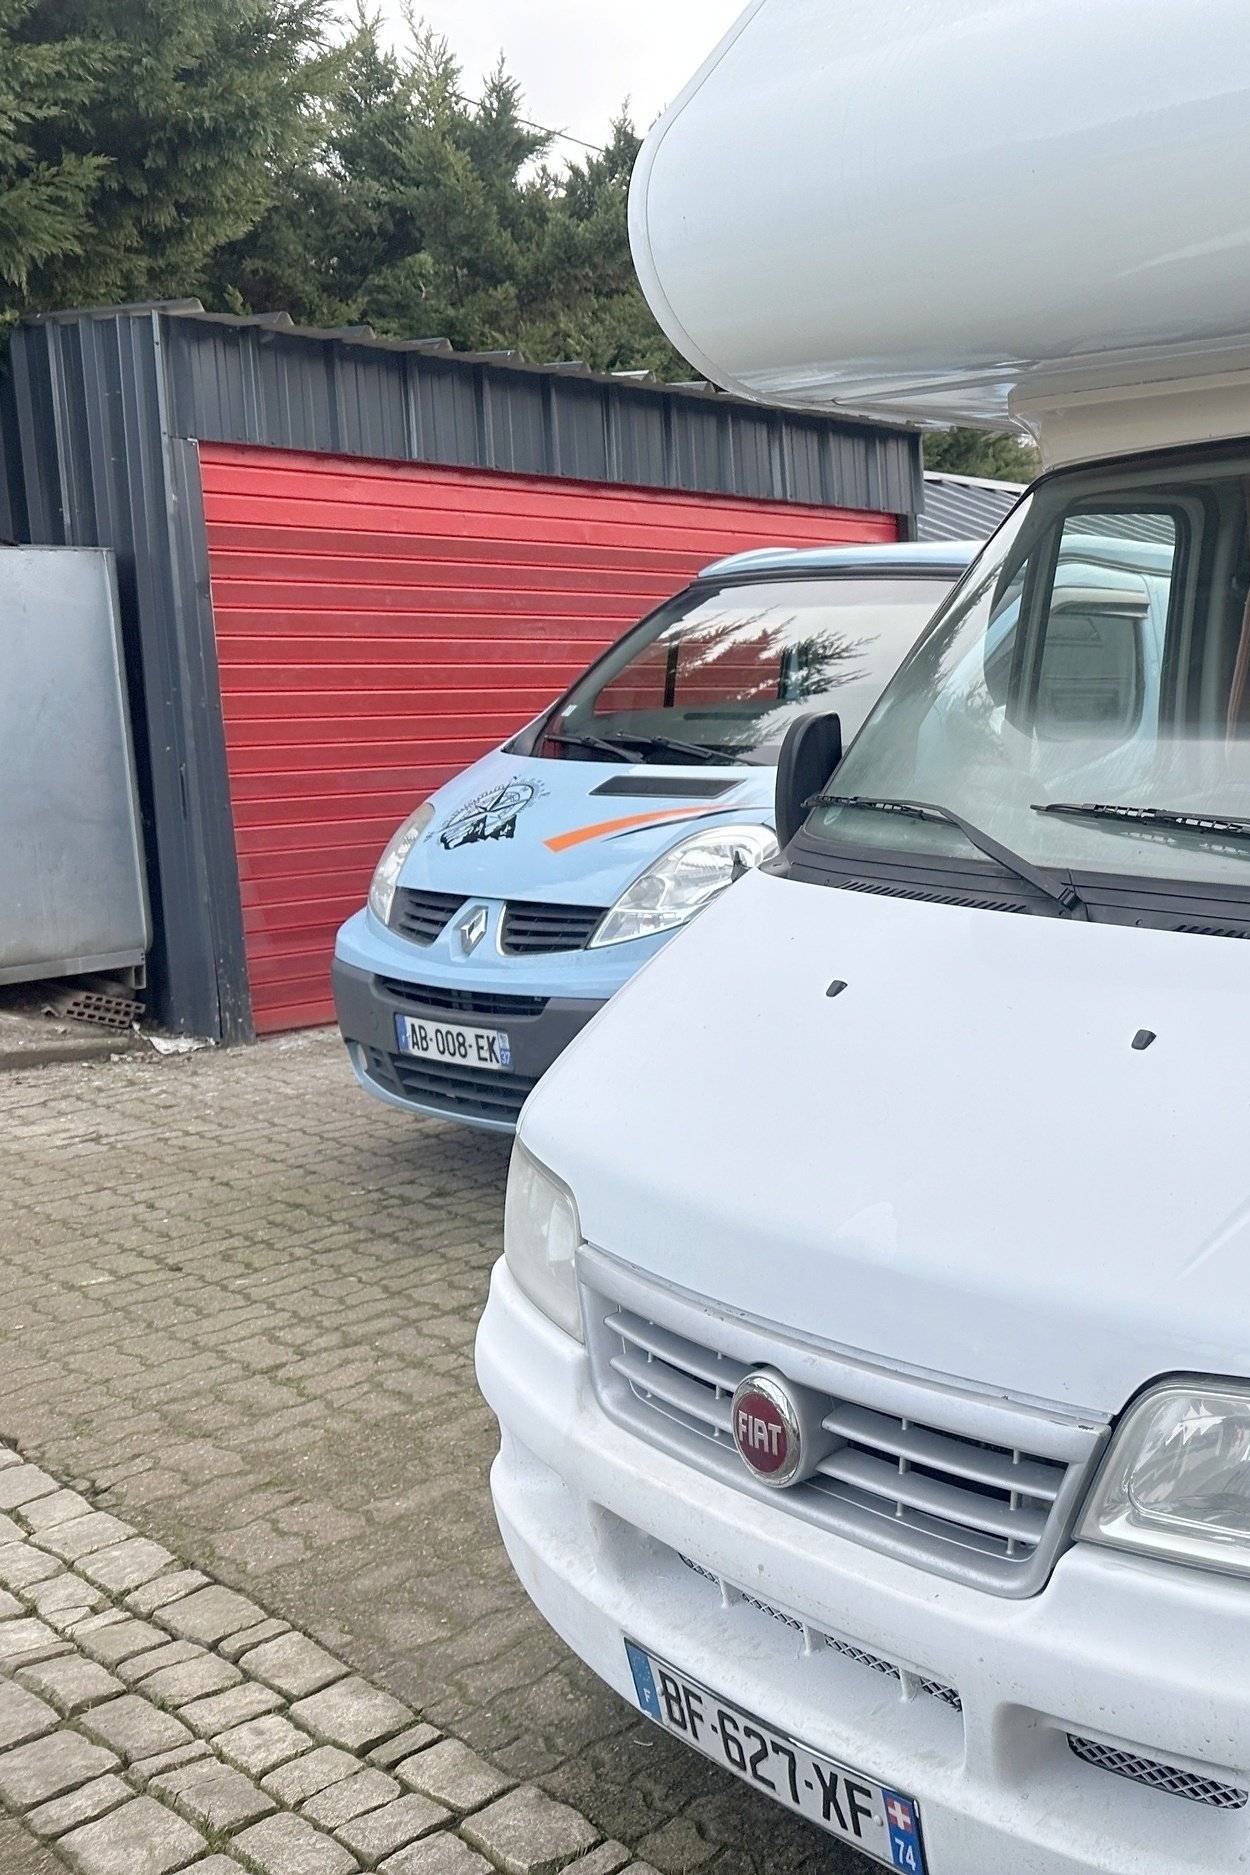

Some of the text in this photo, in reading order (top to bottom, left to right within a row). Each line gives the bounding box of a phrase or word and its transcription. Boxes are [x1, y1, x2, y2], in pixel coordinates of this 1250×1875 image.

[738, 1409, 782, 1456] FIAT
[643, 1688, 651, 1703] F
[659, 1669, 873, 1838] BF-627-XF
[894, 1837, 917, 1871] 74
